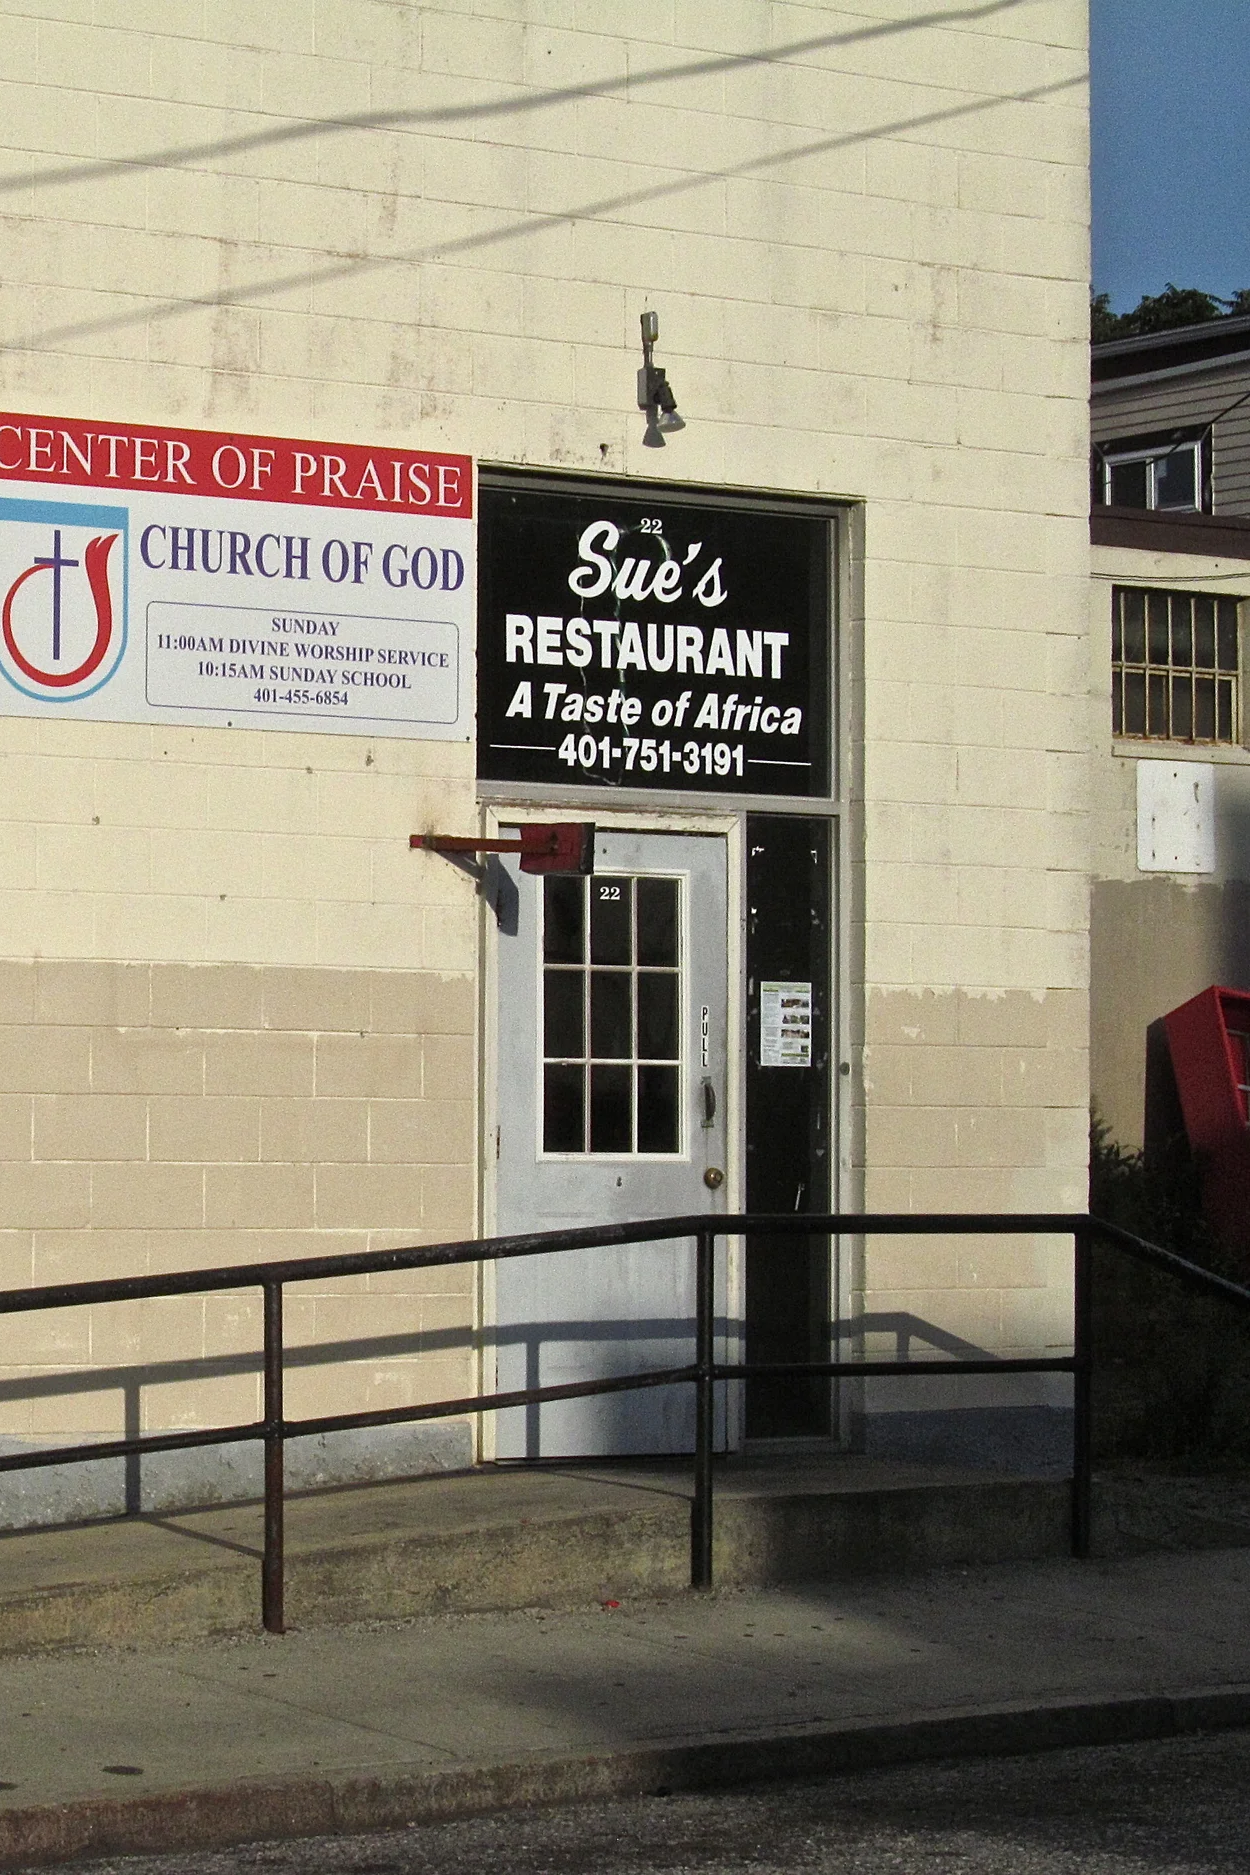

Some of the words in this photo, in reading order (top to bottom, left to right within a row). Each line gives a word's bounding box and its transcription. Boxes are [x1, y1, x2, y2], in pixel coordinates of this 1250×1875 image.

[211, 445, 275, 489] OF
[291, 452, 463, 508] PRAISE
[640, 518, 663, 534] 22
[140, 524, 310, 580] CHURCH
[322, 538, 373, 584] OF
[383, 543, 465, 591] GOD
[568, 520, 728, 607] Sue's
[271, 617, 340, 636] SUNDAY
[505, 613, 789, 679] RESTAURANT
[157, 634, 224, 652] 11:00AM
[229, 638, 290, 657] DIVINE
[294, 643, 374, 662] WORSHIP
[377, 648, 450, 668] SERVICE
[198, 661, 265, 679] 10:15AM
[269, 665, 338, 684] SUNDAY
[341, 670, 412, 689] SCHOOL
[253, 687, 349, 706] 401-455-6854
[505, 681, 532, 718] A
[542, 682, 642, 725] Taste
[651, 691, 692, 727] of
[694, 693, 803, 735] Africa
[558, 733, 744, 777] 401-751-3191
[599, 886, 621, 901] 22
[701, 1005, 709, 1068] PULL
